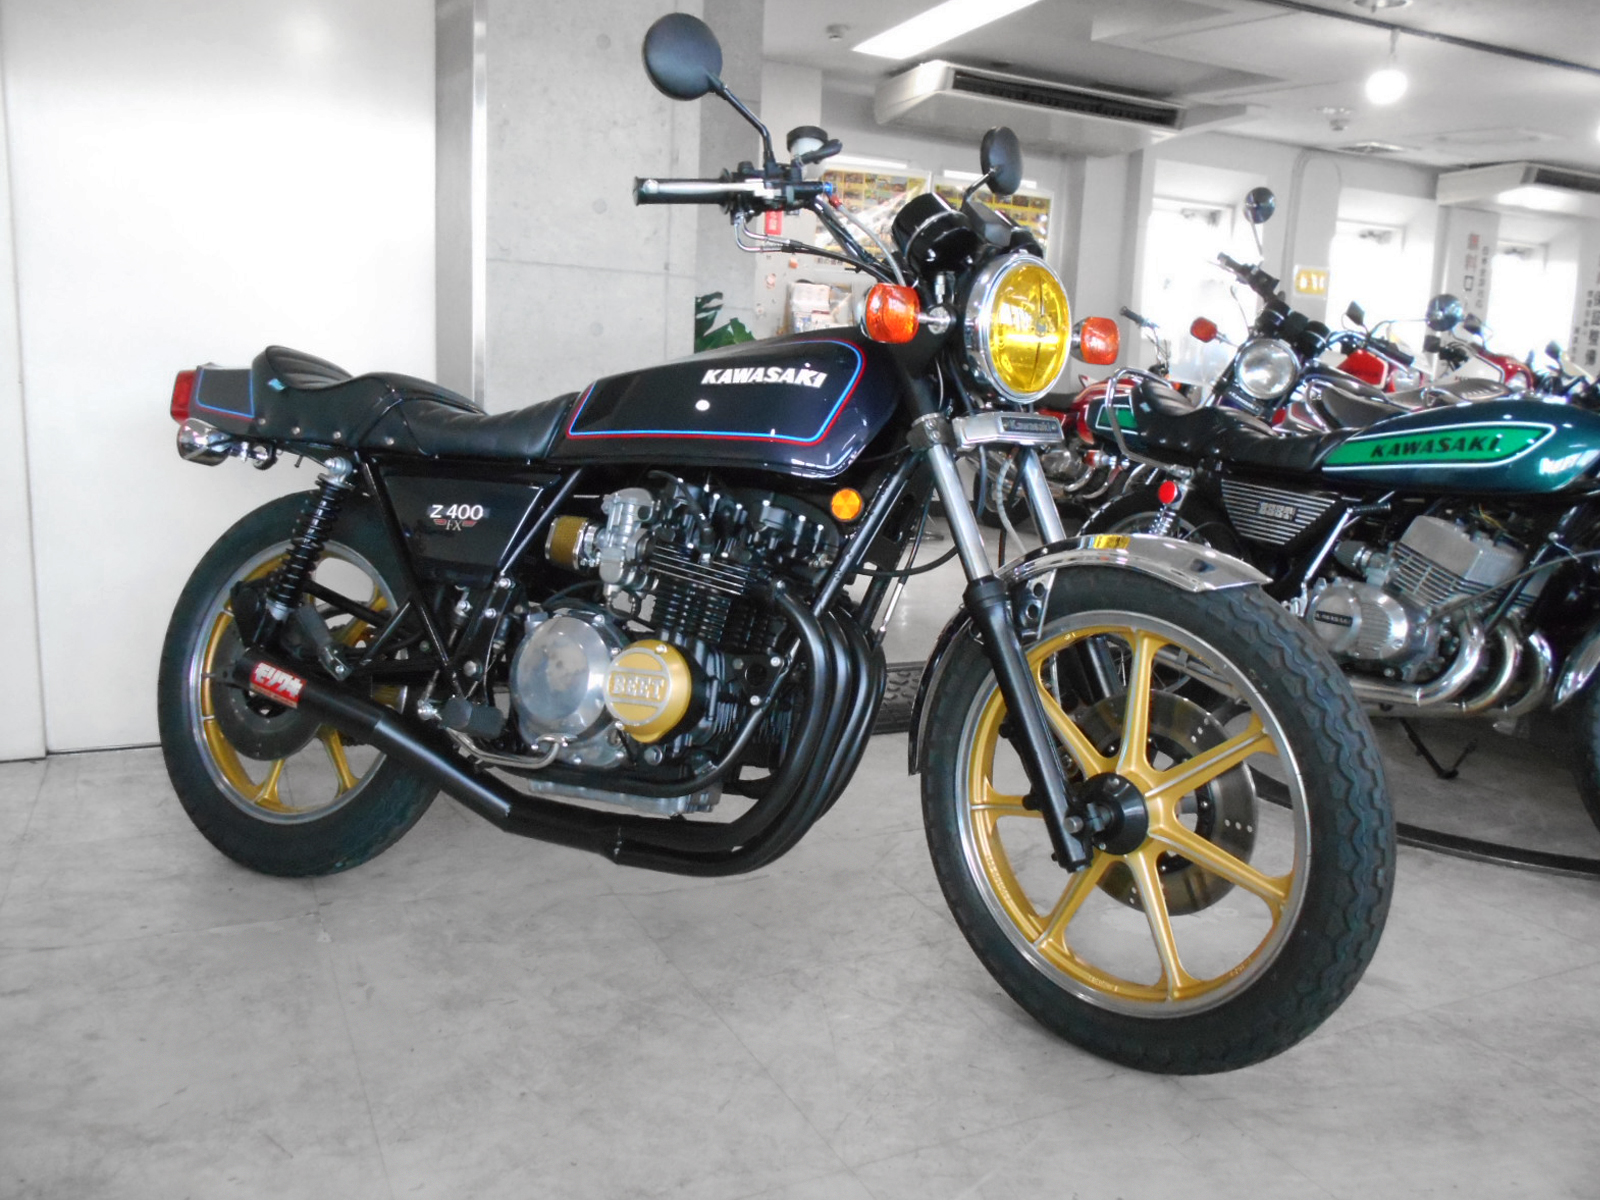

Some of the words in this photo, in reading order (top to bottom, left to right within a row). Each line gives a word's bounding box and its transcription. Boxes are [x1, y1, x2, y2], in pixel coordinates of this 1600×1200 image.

[701, 367, 828, 388] KAWASAKI
[1370, 436, 1500, 458] KAWASAKI
[430, 504, 444, 518] Z
[446, 504, 484, 520] 400
[613, 674, 665, 700] BEET
